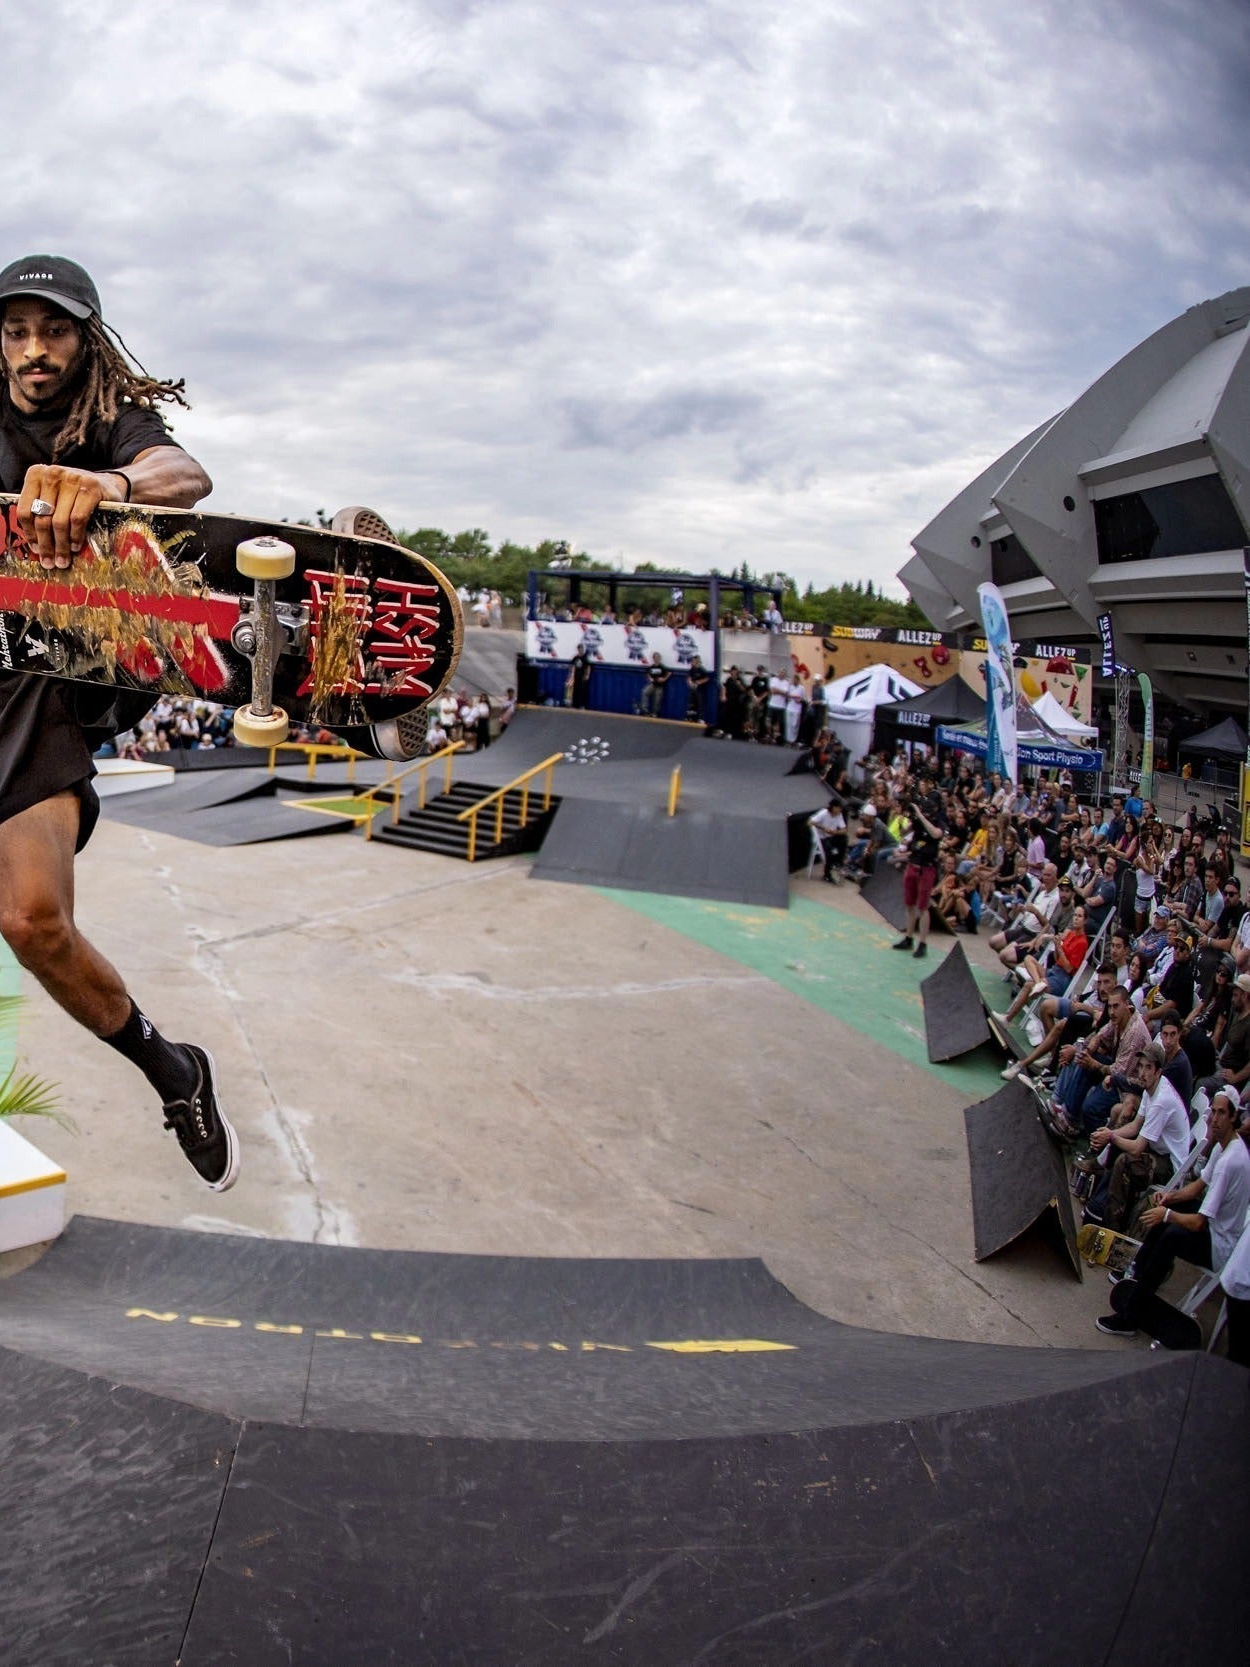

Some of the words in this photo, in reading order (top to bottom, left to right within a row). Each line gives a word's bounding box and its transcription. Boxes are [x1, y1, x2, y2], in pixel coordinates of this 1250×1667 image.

[831, 625, 882, 640] SUBWAY
[898, 629, 932, 645] ALLEZ
[932, 632, 942, 641] UP
[1035, 644, 1067, 659] ALLEZ
[1066, 648, 1076, 657] UP
[898, 711, 922, 726] ALLEZ
[1032, 749, 1055, 762] Sport
[1056, 751, 1084, 766] Physio
